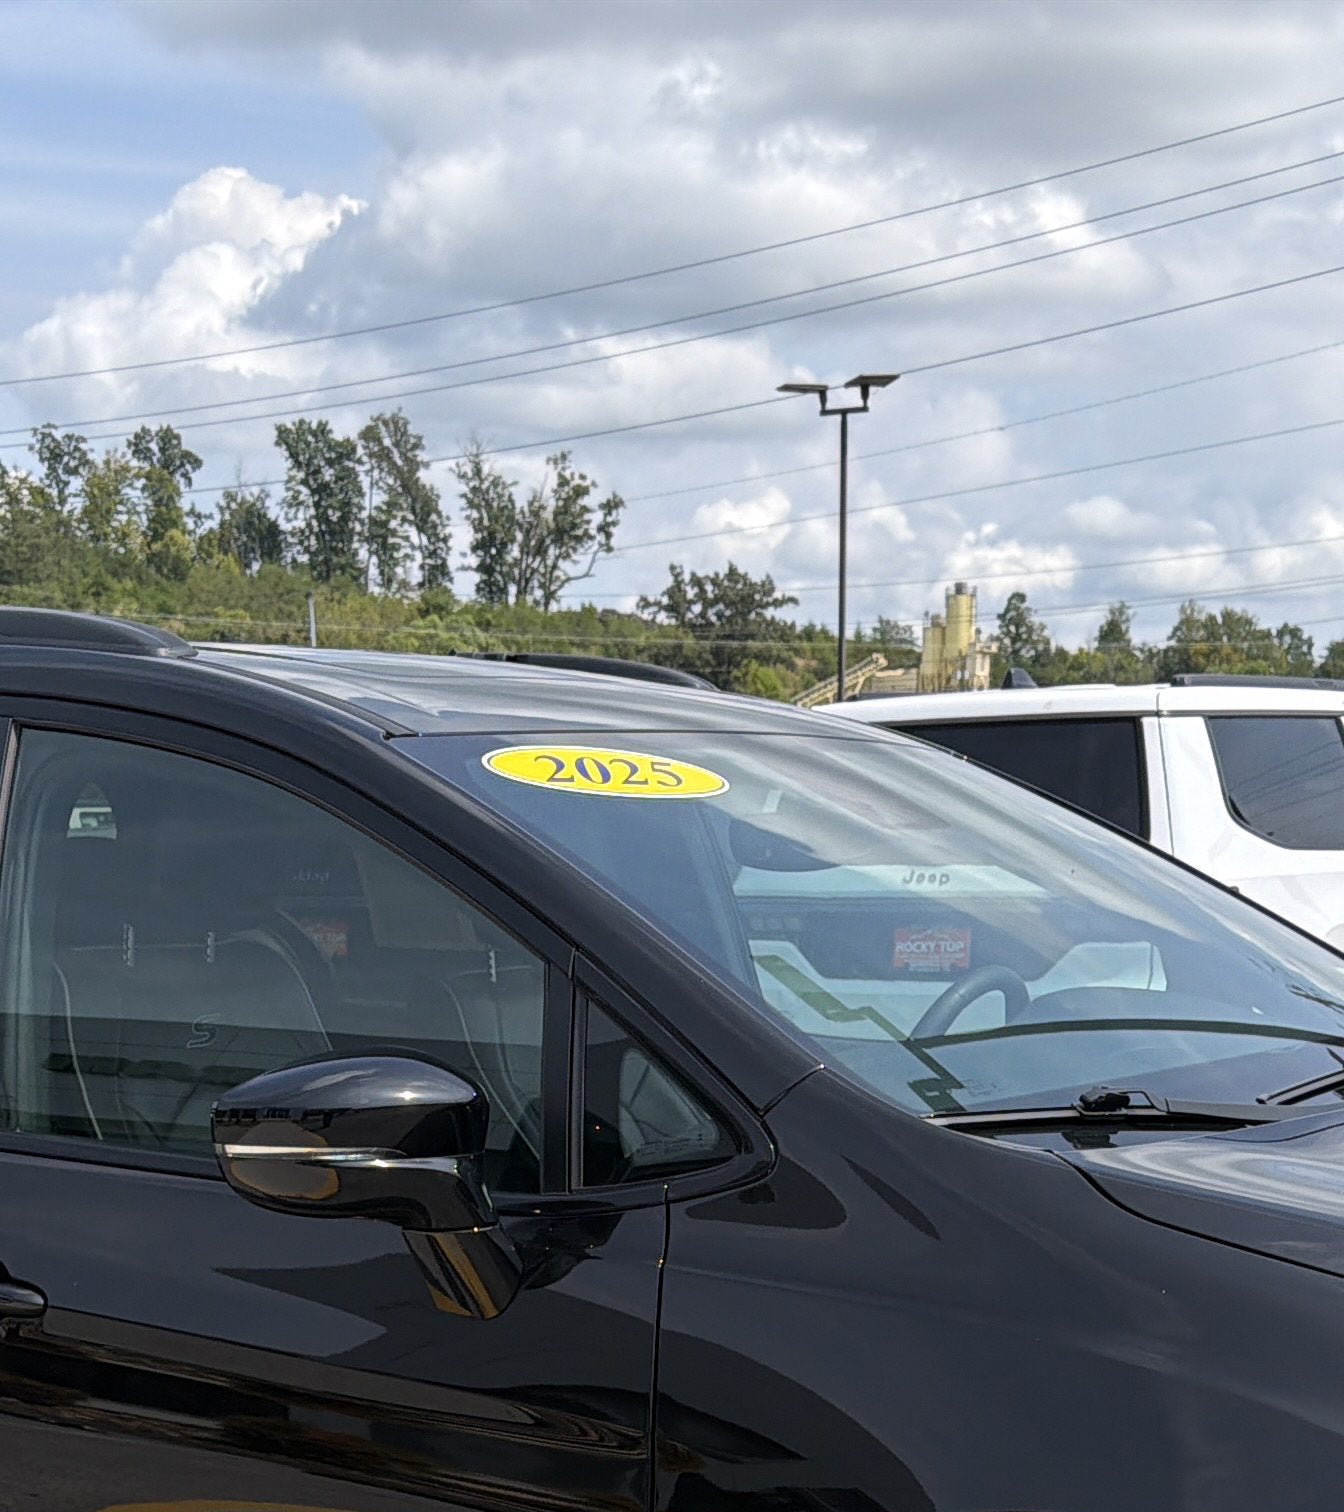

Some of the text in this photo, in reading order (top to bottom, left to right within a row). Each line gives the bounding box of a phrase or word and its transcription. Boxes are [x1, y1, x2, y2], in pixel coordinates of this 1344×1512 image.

[534, 755, 683, 787] 2025
[902, 869, 950, 886] Jeep
[895, 941, 965, 952] ROCKY TOP
